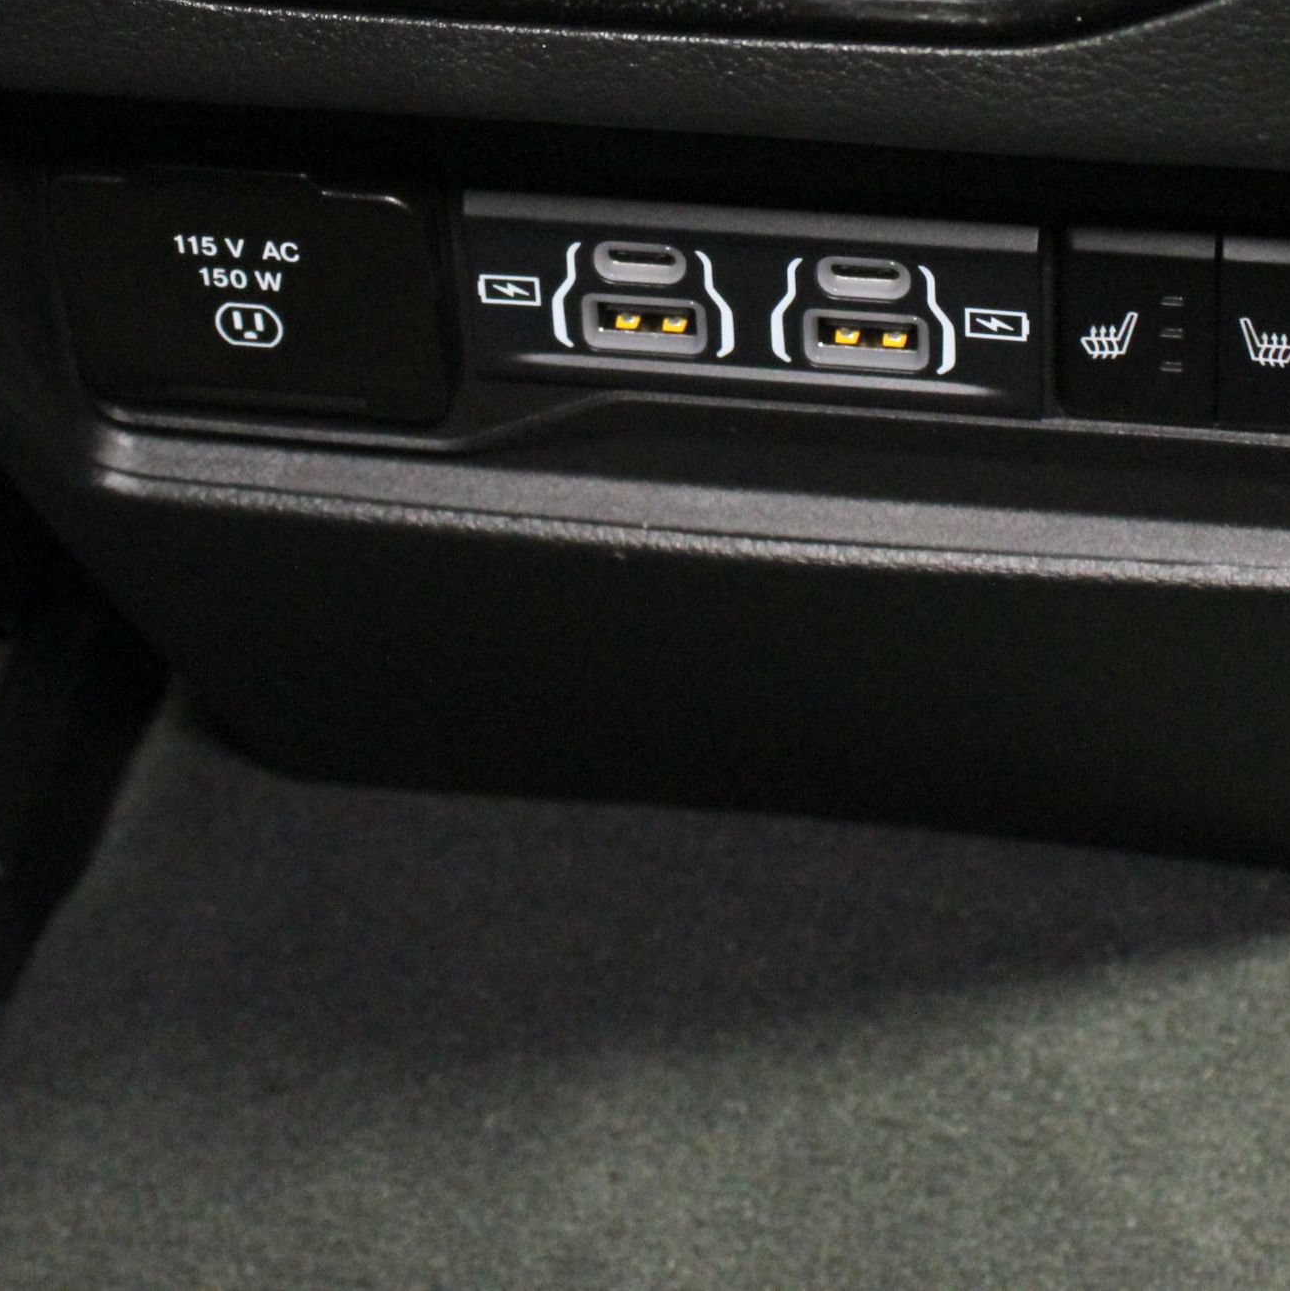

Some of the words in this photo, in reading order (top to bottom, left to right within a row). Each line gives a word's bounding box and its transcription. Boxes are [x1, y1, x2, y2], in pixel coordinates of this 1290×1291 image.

[173, 234, 218, 257] 115
[223, 237, 245, 259] V
[261, 240, 301, 263] AC
[198, 267, 248, 290] 150
[253, 270, 283, 292] W
